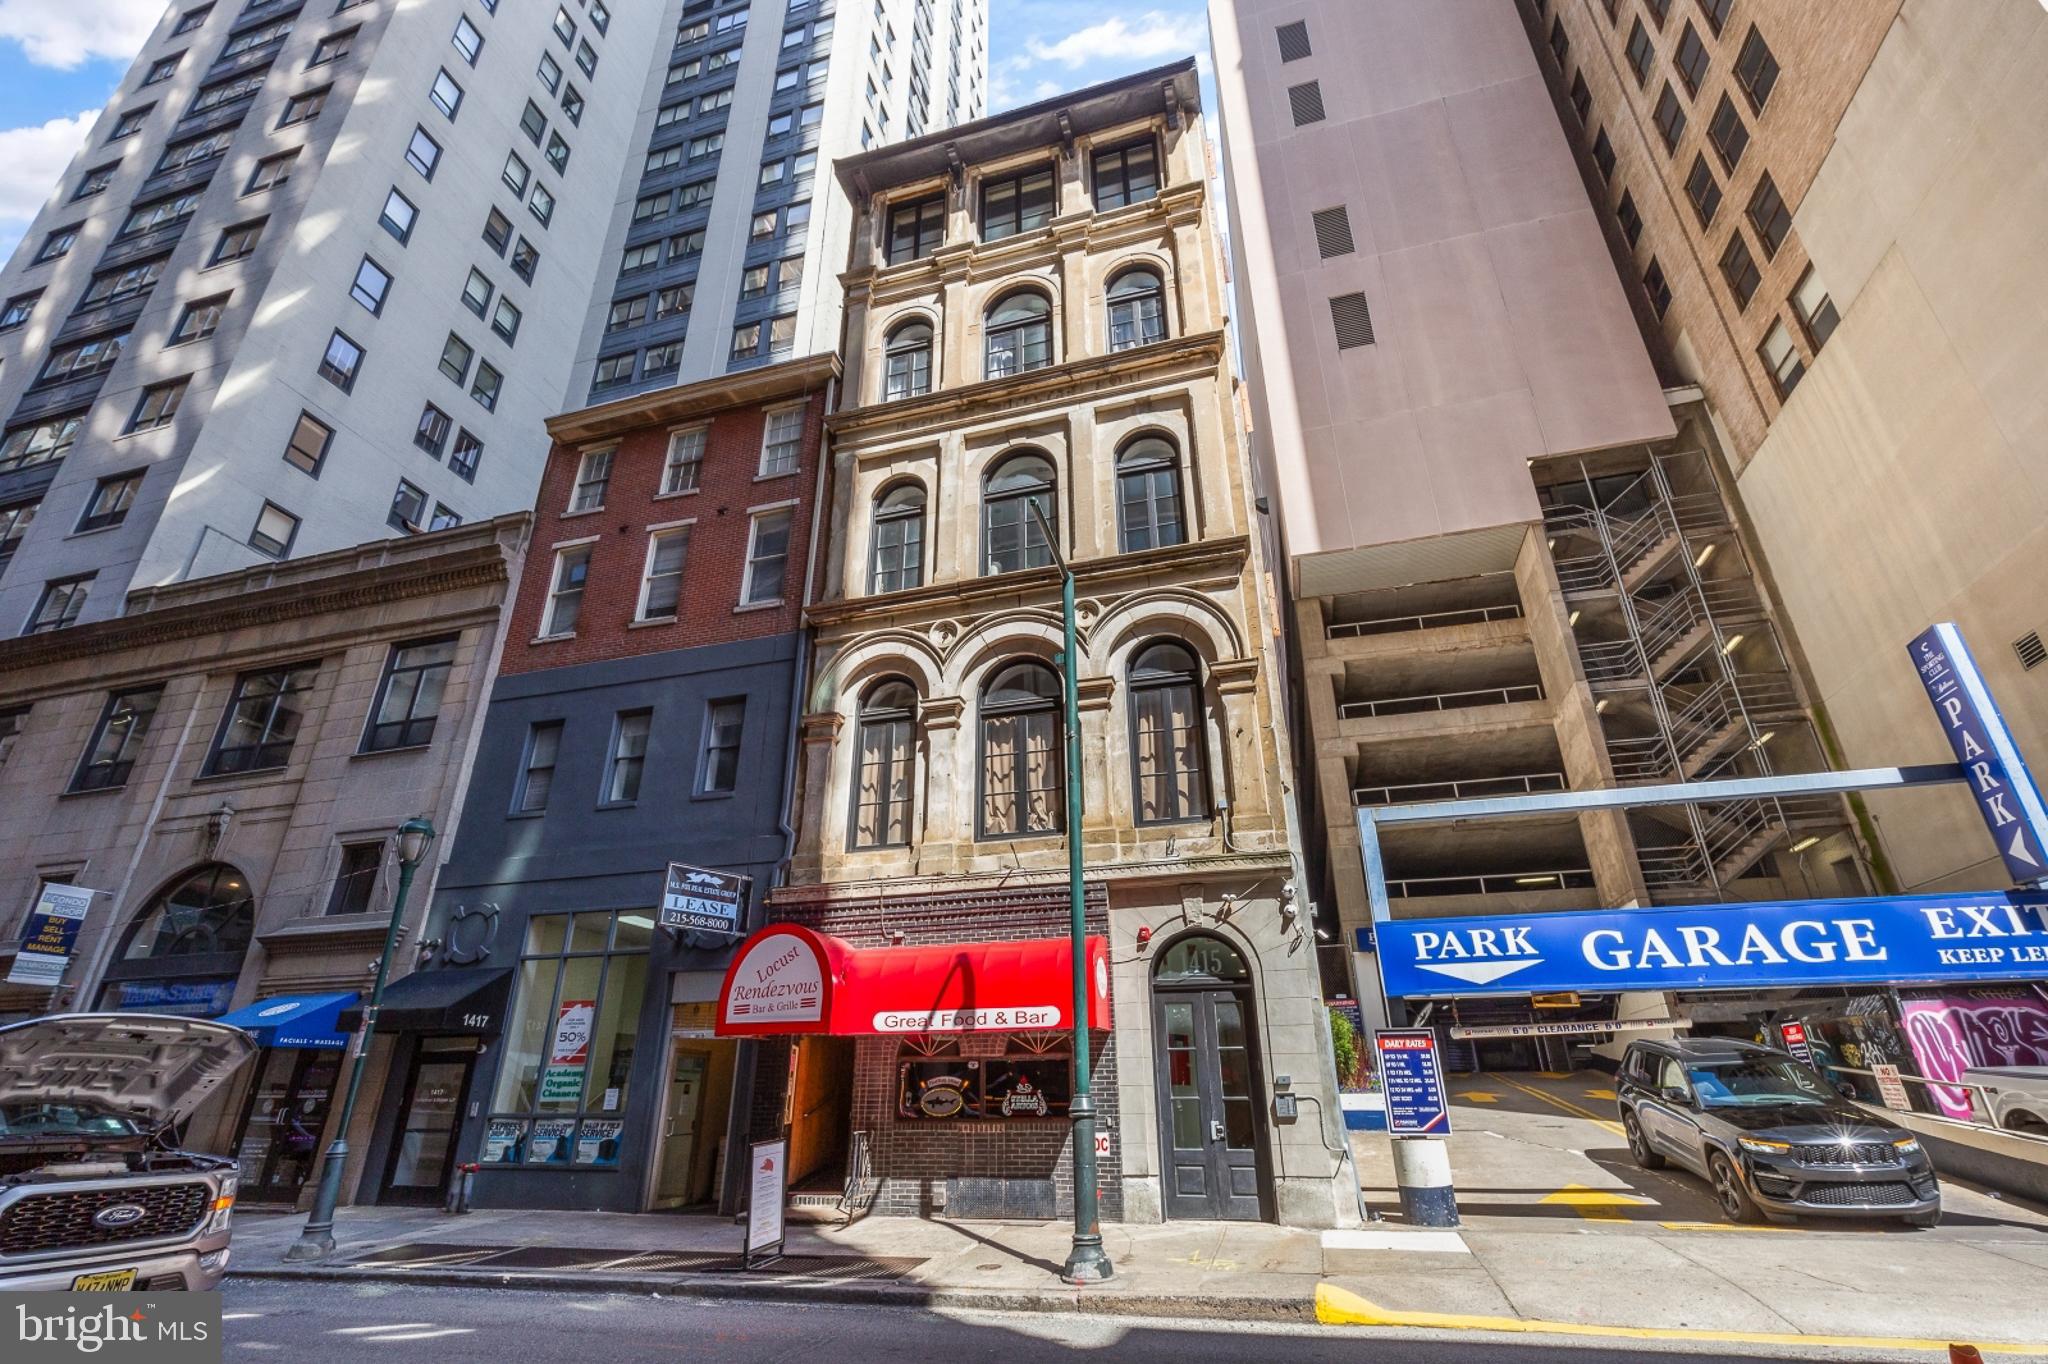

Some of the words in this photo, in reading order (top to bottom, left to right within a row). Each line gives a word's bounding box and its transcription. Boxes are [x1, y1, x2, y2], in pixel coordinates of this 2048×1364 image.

[1944, 697, 2016, 826] PARK
[52, 895, 87, 906] CONDO
[672, 896, 729, 916] LEASE
[54, 906, 83, 916] SHOP
[670, 912, 728, 929] 215-568-8000
[1920, 904, 2048, 938] EXIT
[43, 926, 65, 935] SELL
[38, 934, 63, 944] RENT
[1412, 926, 1540, 960] PARK
[1581, 919, 1888, 970] GARAGE
[26, 943, 65, 954] MANAGE
[1182, 949, 1224, 974] 1415
[1938, 948, 2004, 964] KEEP
[756, 946, 800, 983] Locust
[734, 980, 819, 1001] Rendezvous
[752, 1004, 765, 1014] Bar
[768, 1003, 774, 1012] &
[776, 1000, 798, 1011] Grille
[463, 1014, 489, 1027] 1417
[884, 1015, 933, 1028] Great
[942, 1012, 987, 1027] Food
[995, 1011, 1008, 1024] &
[1015, 1011, 1048, 1024] Bar
[1537, 1023, 1599, 1033] CLEARANCE
[559, 1032, 586, 1042] 50%
[546, 1080, 580, 1088] Organic
[109, 1210, 135, 1220] Ford
